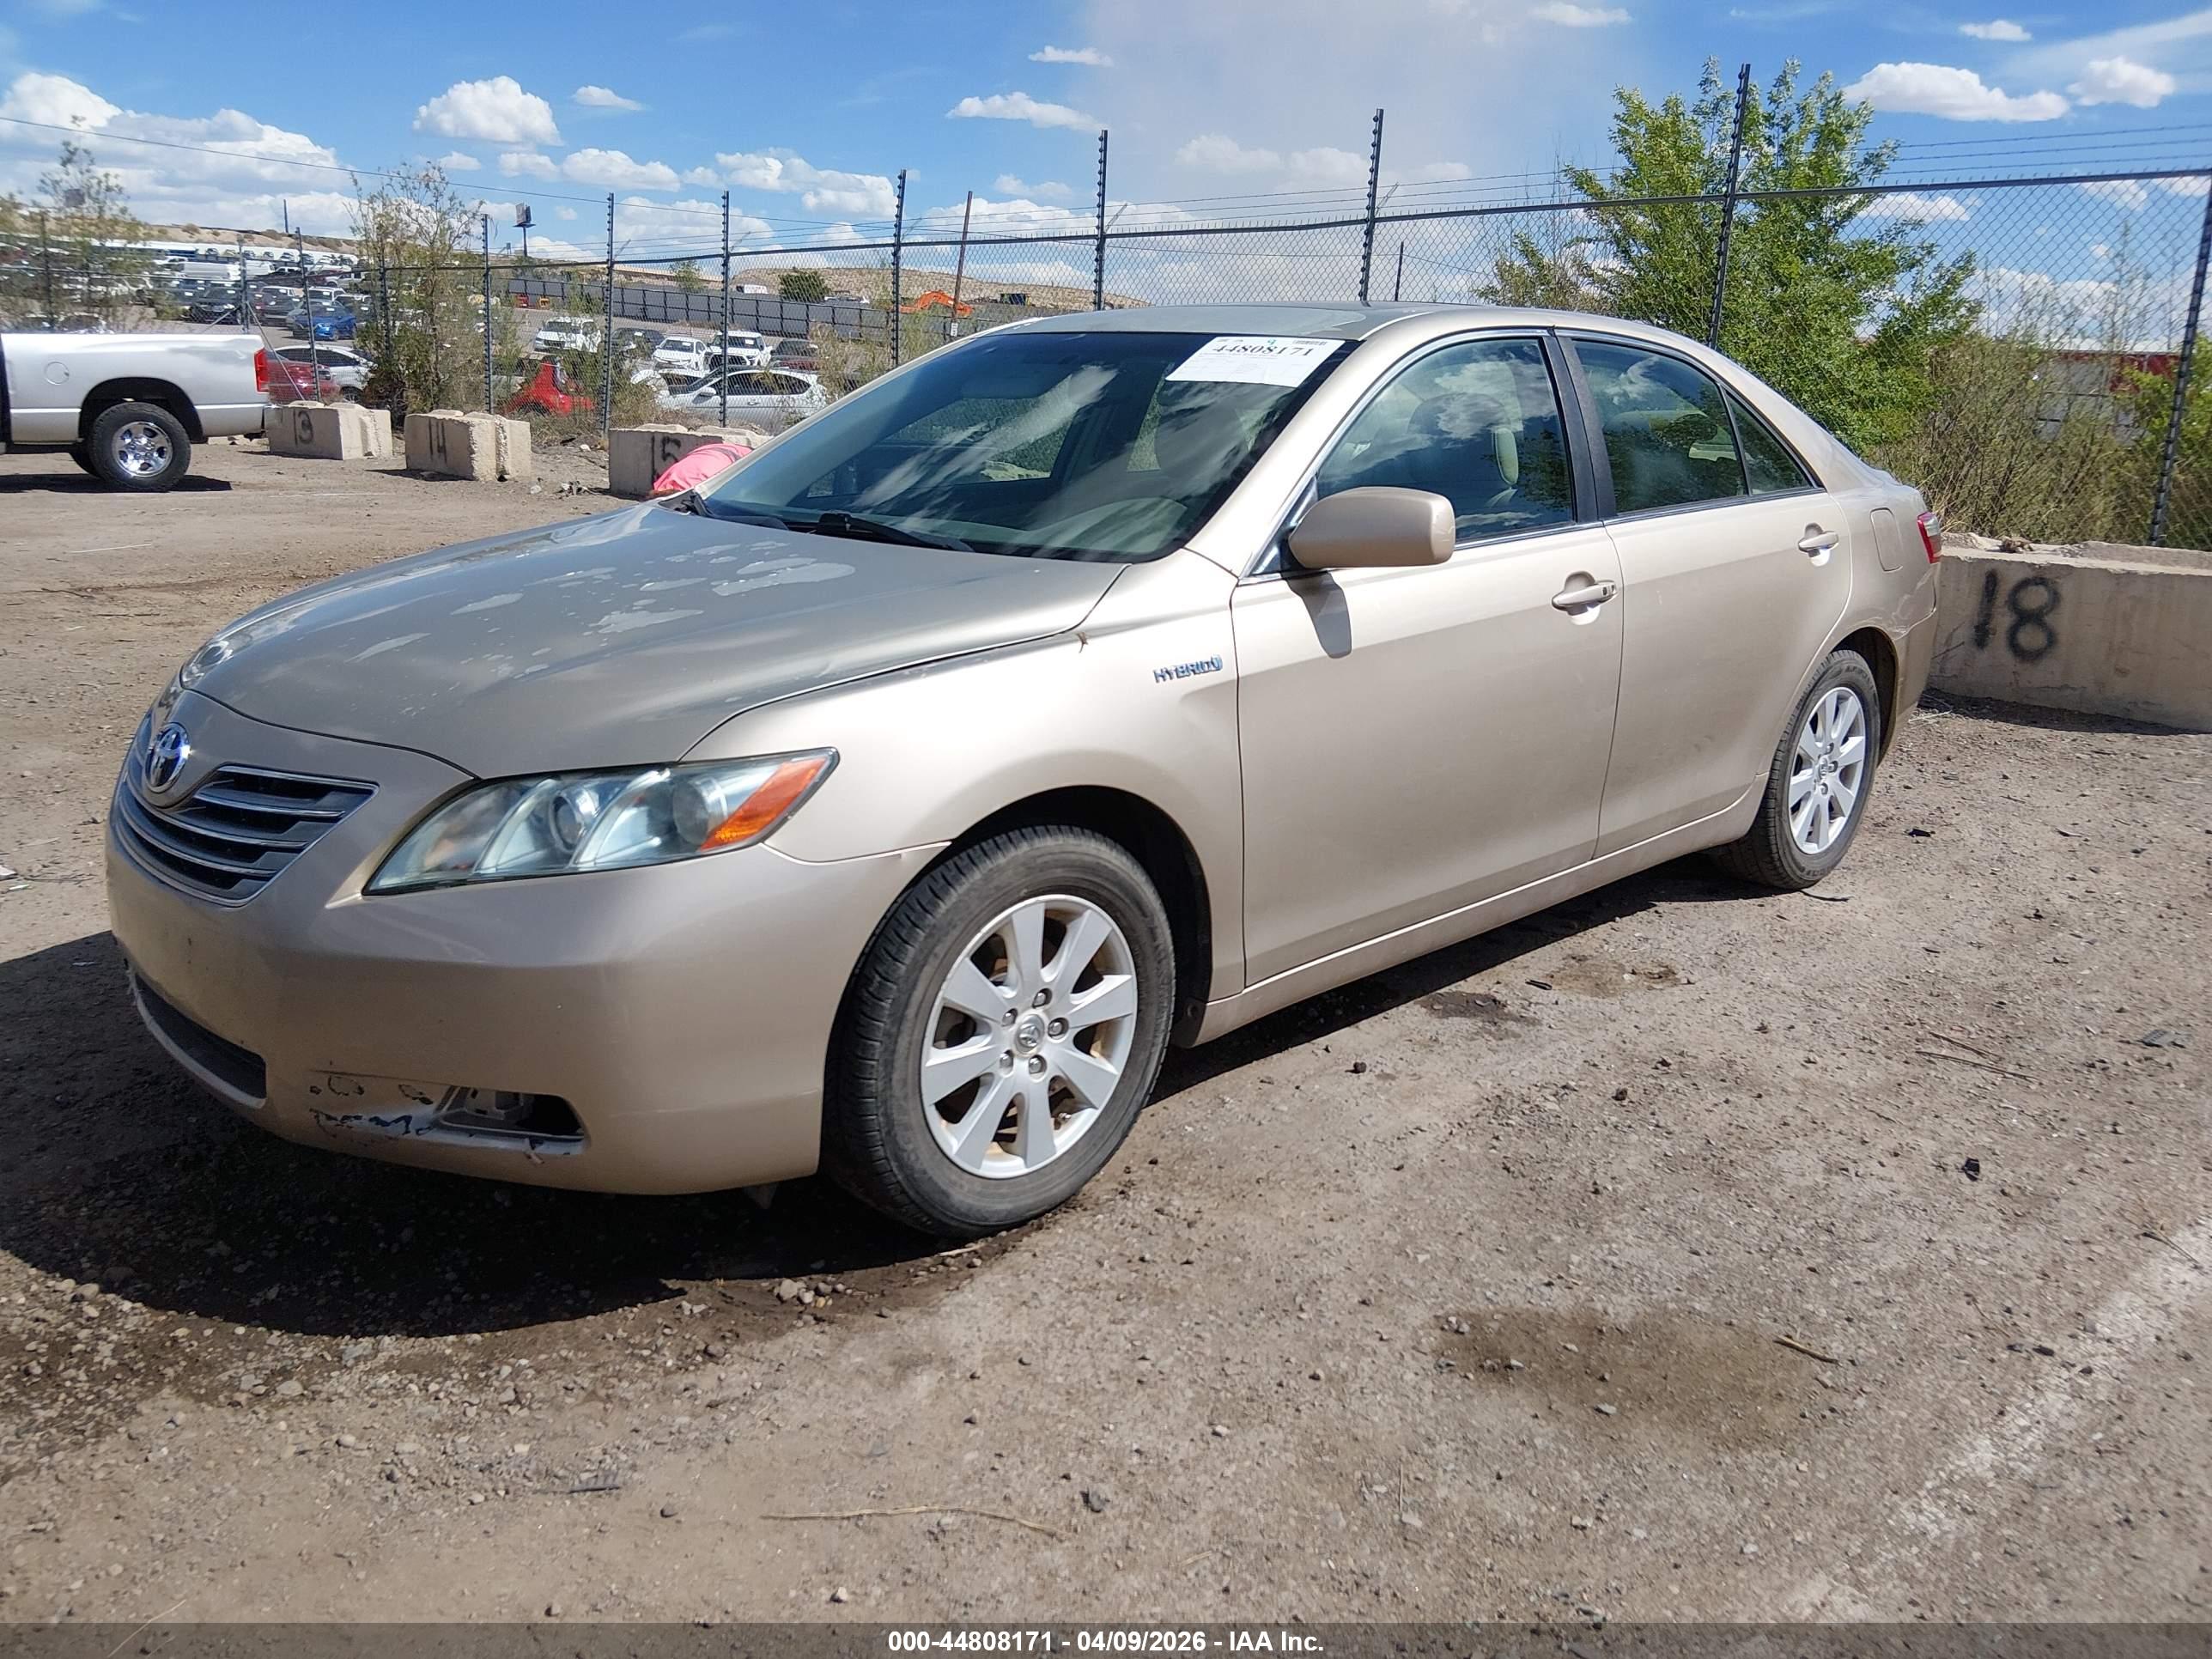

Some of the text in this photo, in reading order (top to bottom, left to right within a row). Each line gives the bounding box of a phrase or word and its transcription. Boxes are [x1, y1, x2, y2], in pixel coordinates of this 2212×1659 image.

[1212, 344, 1315, 356] 44808171
[428, 417, 448, 465] 14
[651, 435, 682, 484] 15
[1972, 569, 2062, 662] 18
[1153, 659, 1213, 684] HYBRID
